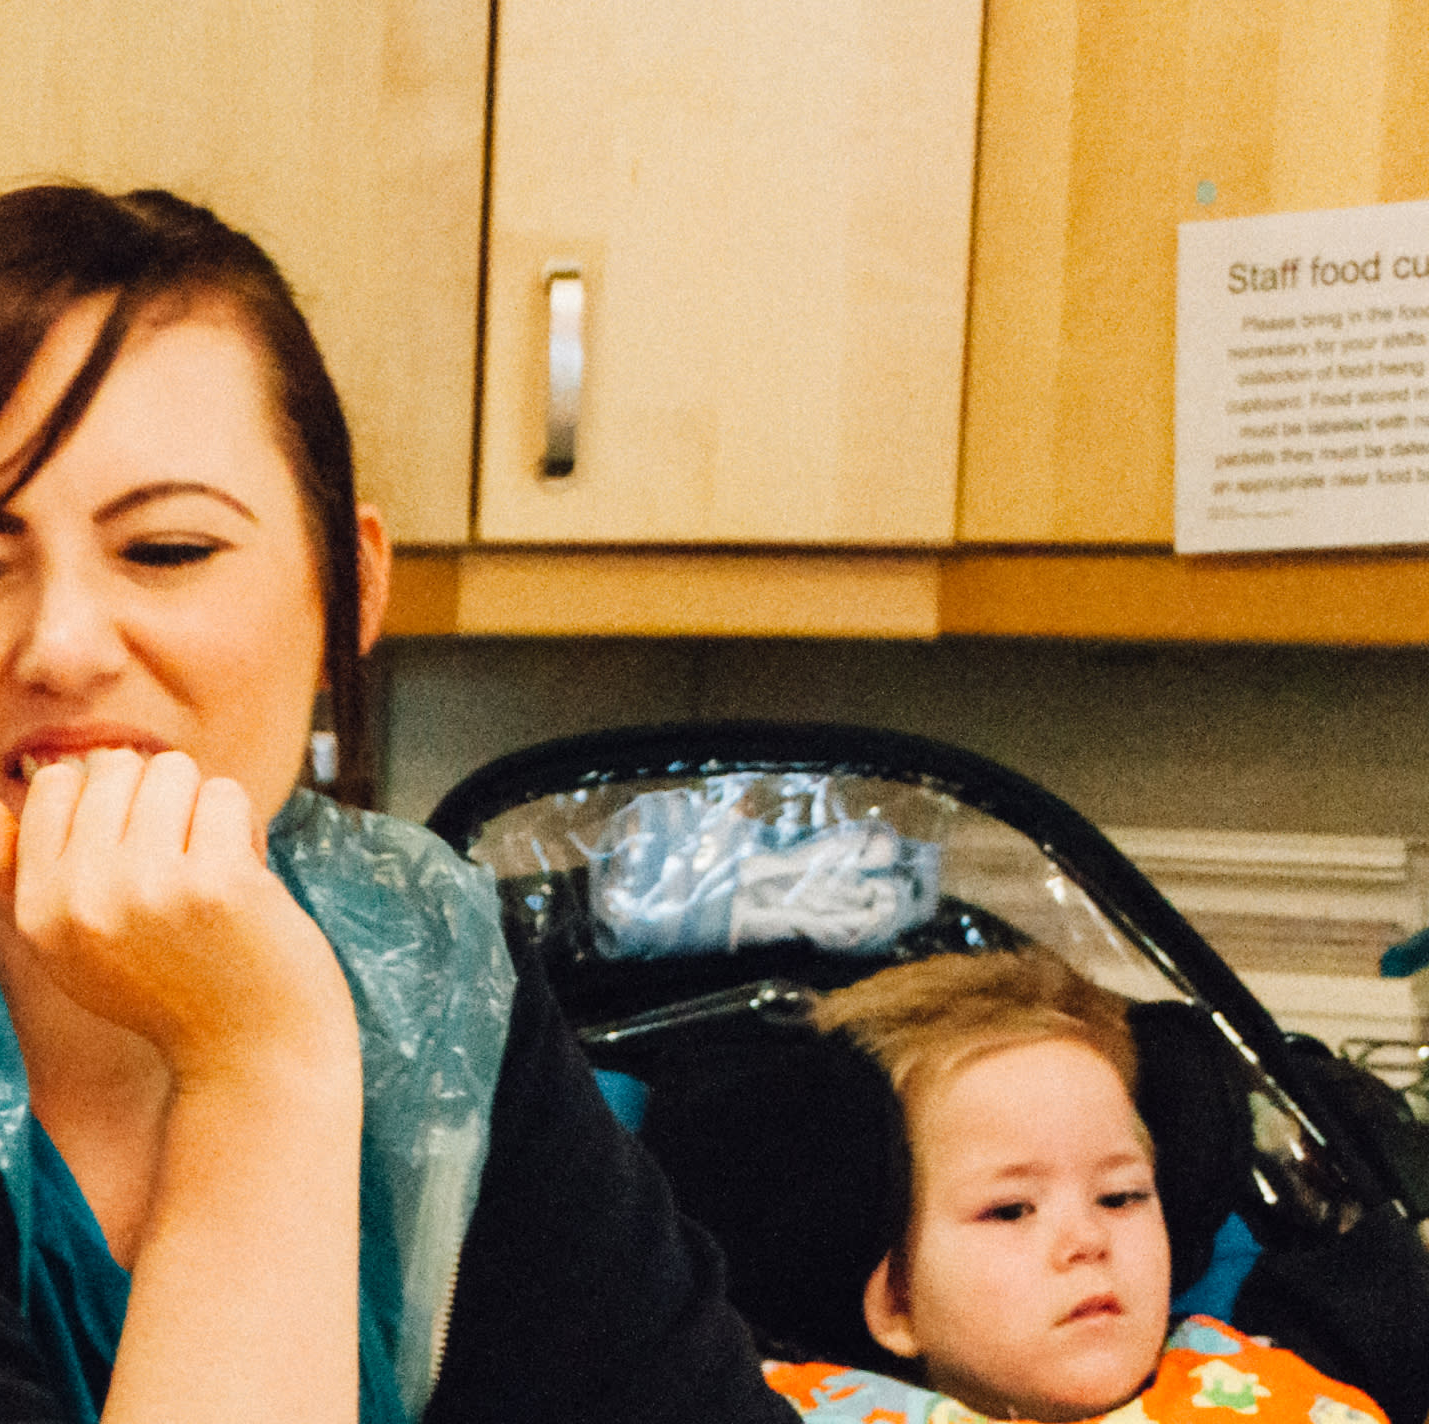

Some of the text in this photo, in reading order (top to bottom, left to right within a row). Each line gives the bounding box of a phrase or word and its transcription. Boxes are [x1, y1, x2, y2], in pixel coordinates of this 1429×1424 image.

[1228, 257, 1300, 294] Staff
[1310, 250, 1381, 288] food
[1242, 315, 1295, 331] Please
[1302, 312, 1342, 330] bring
[1348, 310, 1362, 323] in
[1367, 306, 1393, 322] the
[1228, 344, 1306, 360] necessary
[1315, 338, 1335, 352] for
[1341, 338, 1377, 354] your
[1238, 360, 1425, 388] collection of food being
[1311, 391, 1351, 409] Food
[1358, 386, 1409, 404] stored
[1240, 422, 1277, 438] must
[1283, 421, 1301, 437] be
[1376, 414, 1408, 431] with
[1280, 447, 1313, 465] they
[1319, 446, 1358, 461] must
[1364, 443, 1384, 458] be
[1236, 473, 1325, 494] appropriate
[1376, 468, 1412, 485] food
